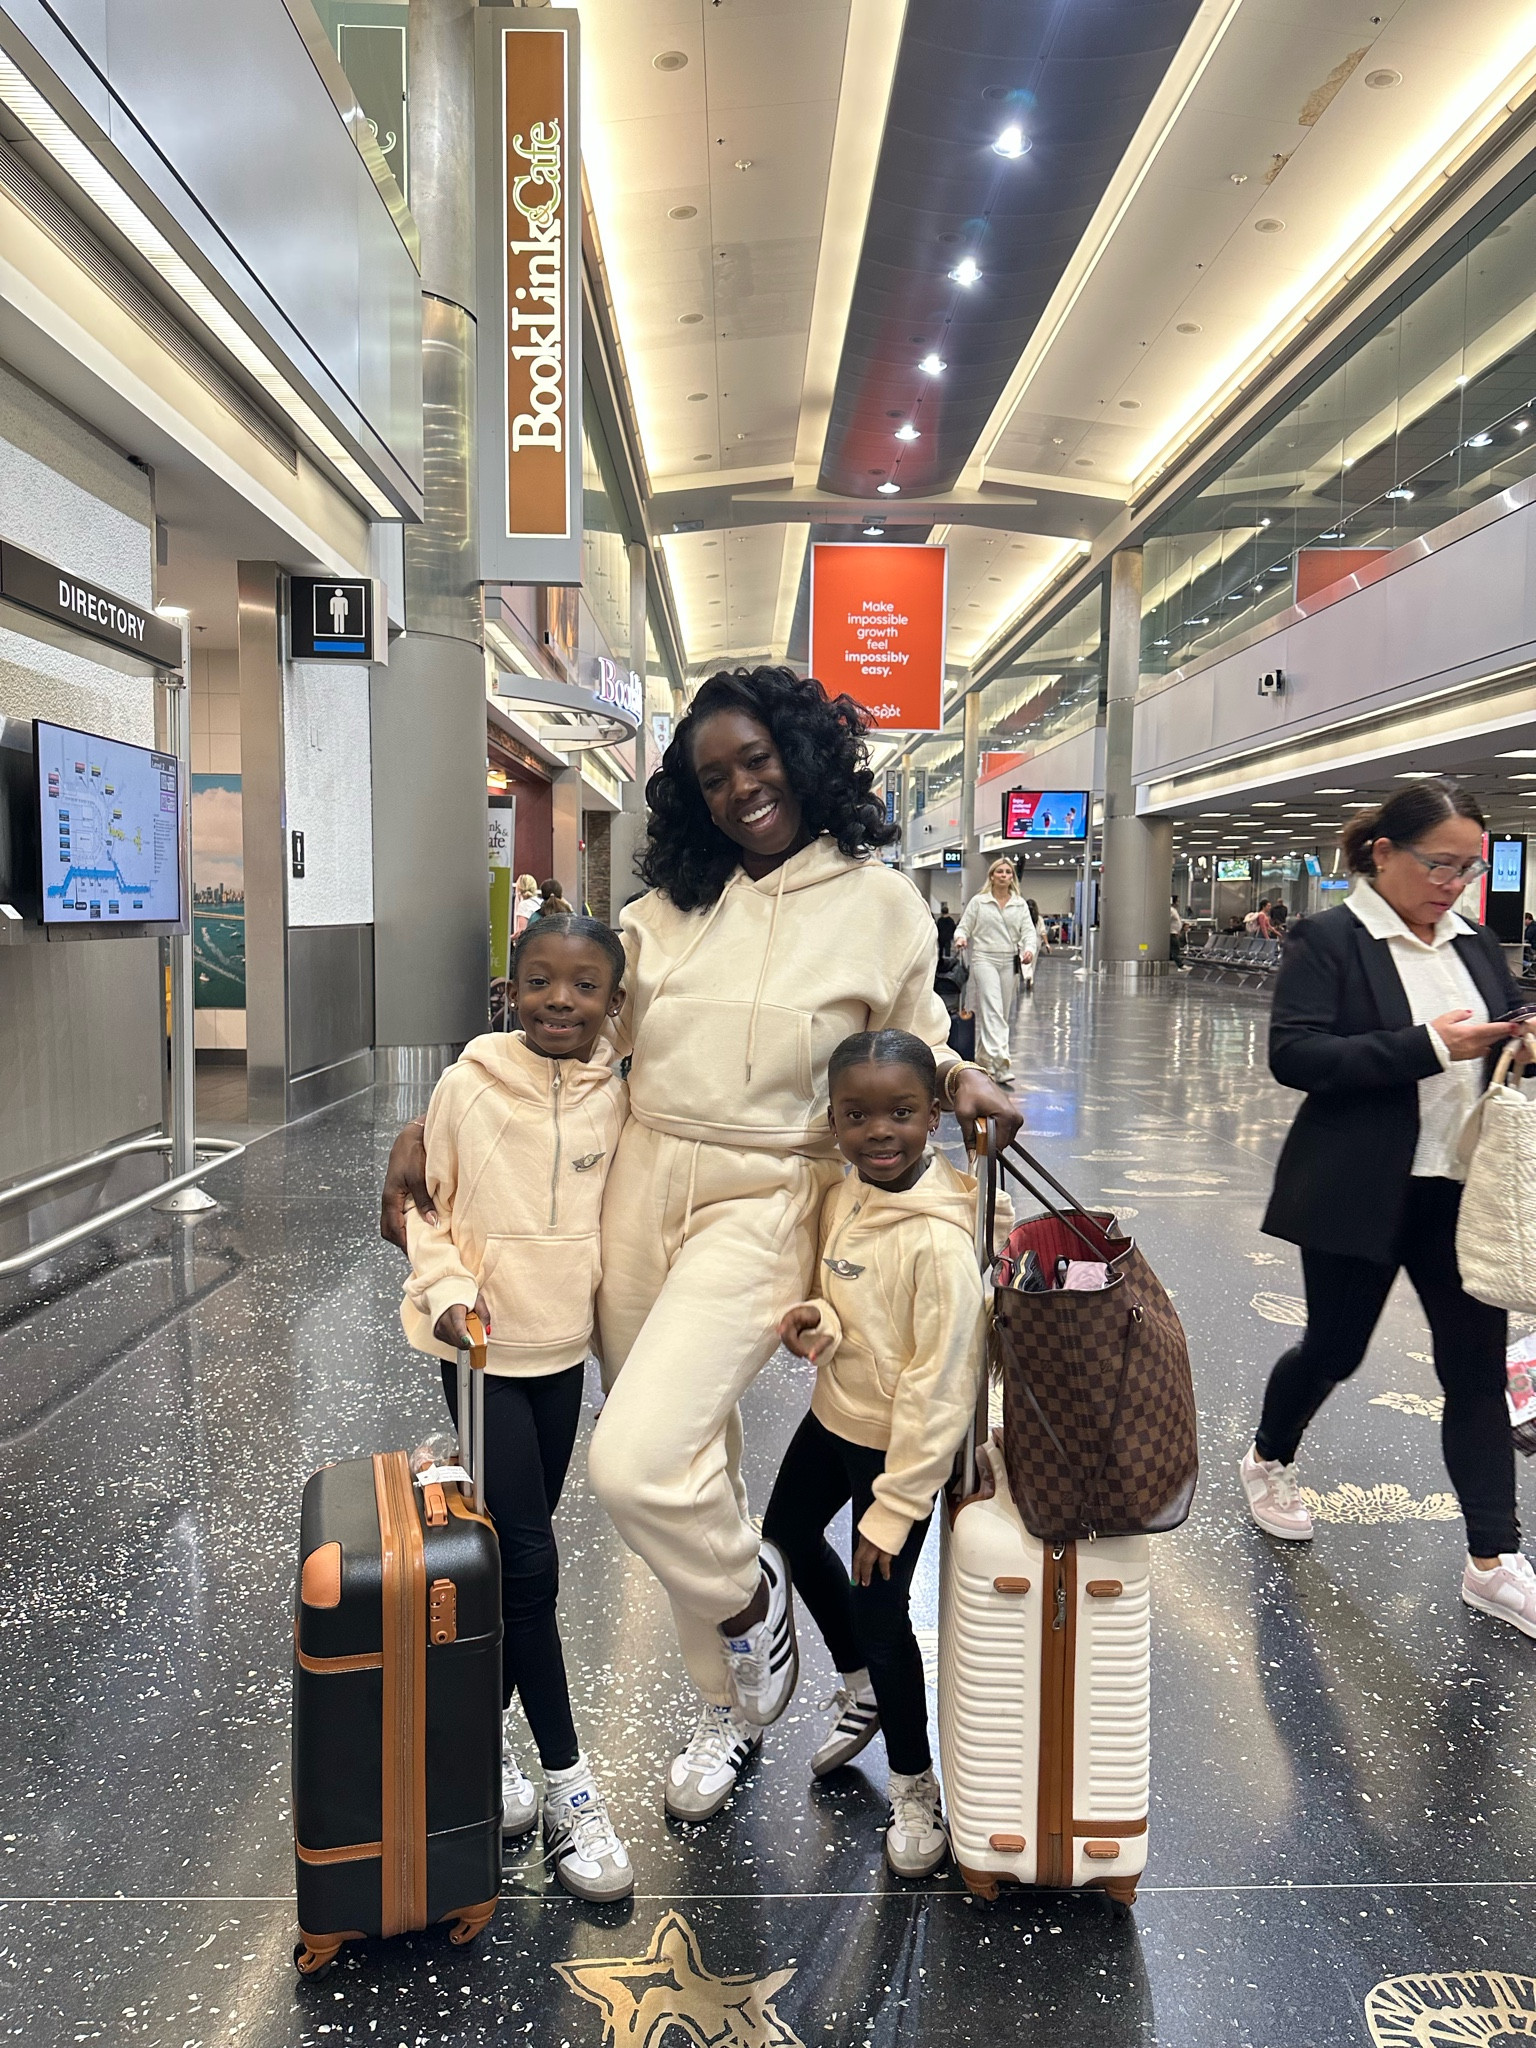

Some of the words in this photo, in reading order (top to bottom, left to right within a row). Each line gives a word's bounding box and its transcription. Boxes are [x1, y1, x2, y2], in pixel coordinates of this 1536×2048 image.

[59, 579, 145, 642] DIRECTORY
[862, 601, 895, 612] Make
[847, 613, 909, 627] impossible
[856, 626, 899, 640] growth
[866, 639, 889, 650] feel
[844, 650, 910, 666] impossibly
[861, 666, 893, 678] easy.
[488, 832, 506, 848] afe
[945, 852, 961, 861] D21
